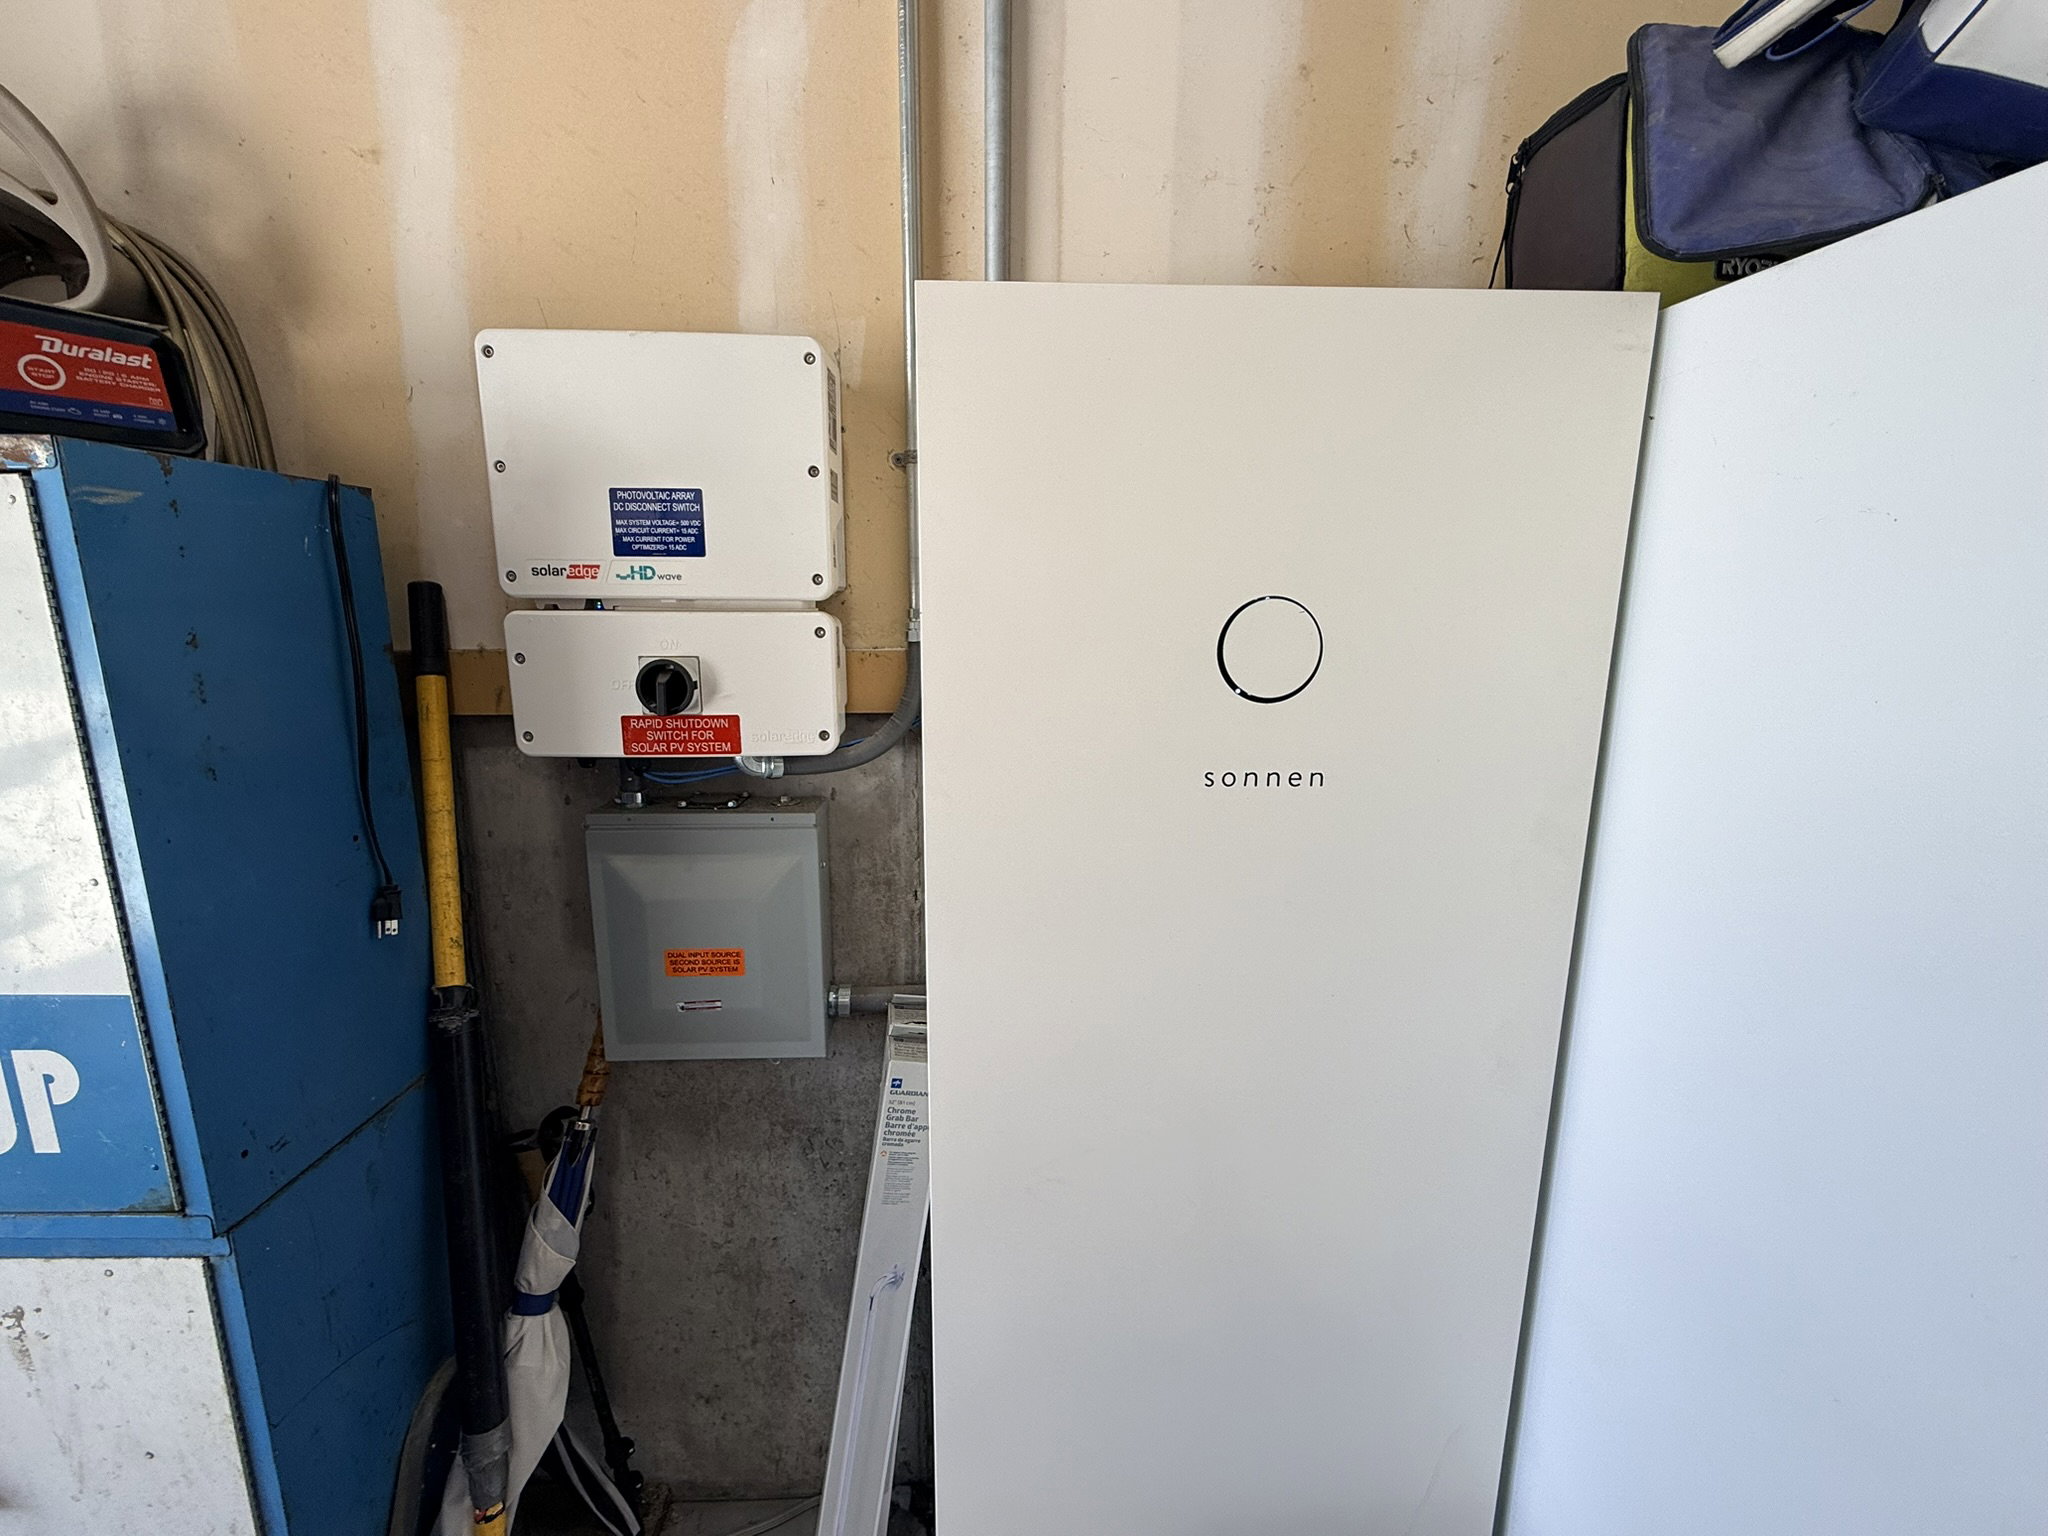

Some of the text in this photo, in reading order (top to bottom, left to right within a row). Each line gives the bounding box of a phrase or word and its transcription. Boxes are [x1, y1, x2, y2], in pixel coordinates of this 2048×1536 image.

[1722, 256, 1779, 275] RYO
[34, 334, 152, 369] Duralast
[616, 490, 695, 500] PHOTOVOLTAIC ARRAY
[613, 502, 700, 512] DC DISCONNECT SWITCH
[531, 564, 600, 579] solaredge
[630, 565, 682, 581] HD wave
[660, 639, 680, 650] ON
[630, 719, 729, 729] RAPID SHUTDOWN
[646, 731, 714, 741] SWITCH FOR
[631, 742, 731, 753] SOLAR PV SYSTEM
[1204, 772, 1324, 787] sonnen
[887, 1106, 916, 1115] Chrome
[885, 1121, 929, 1132] Barre d'app
[883, 1129, 916, 1137] chromée
